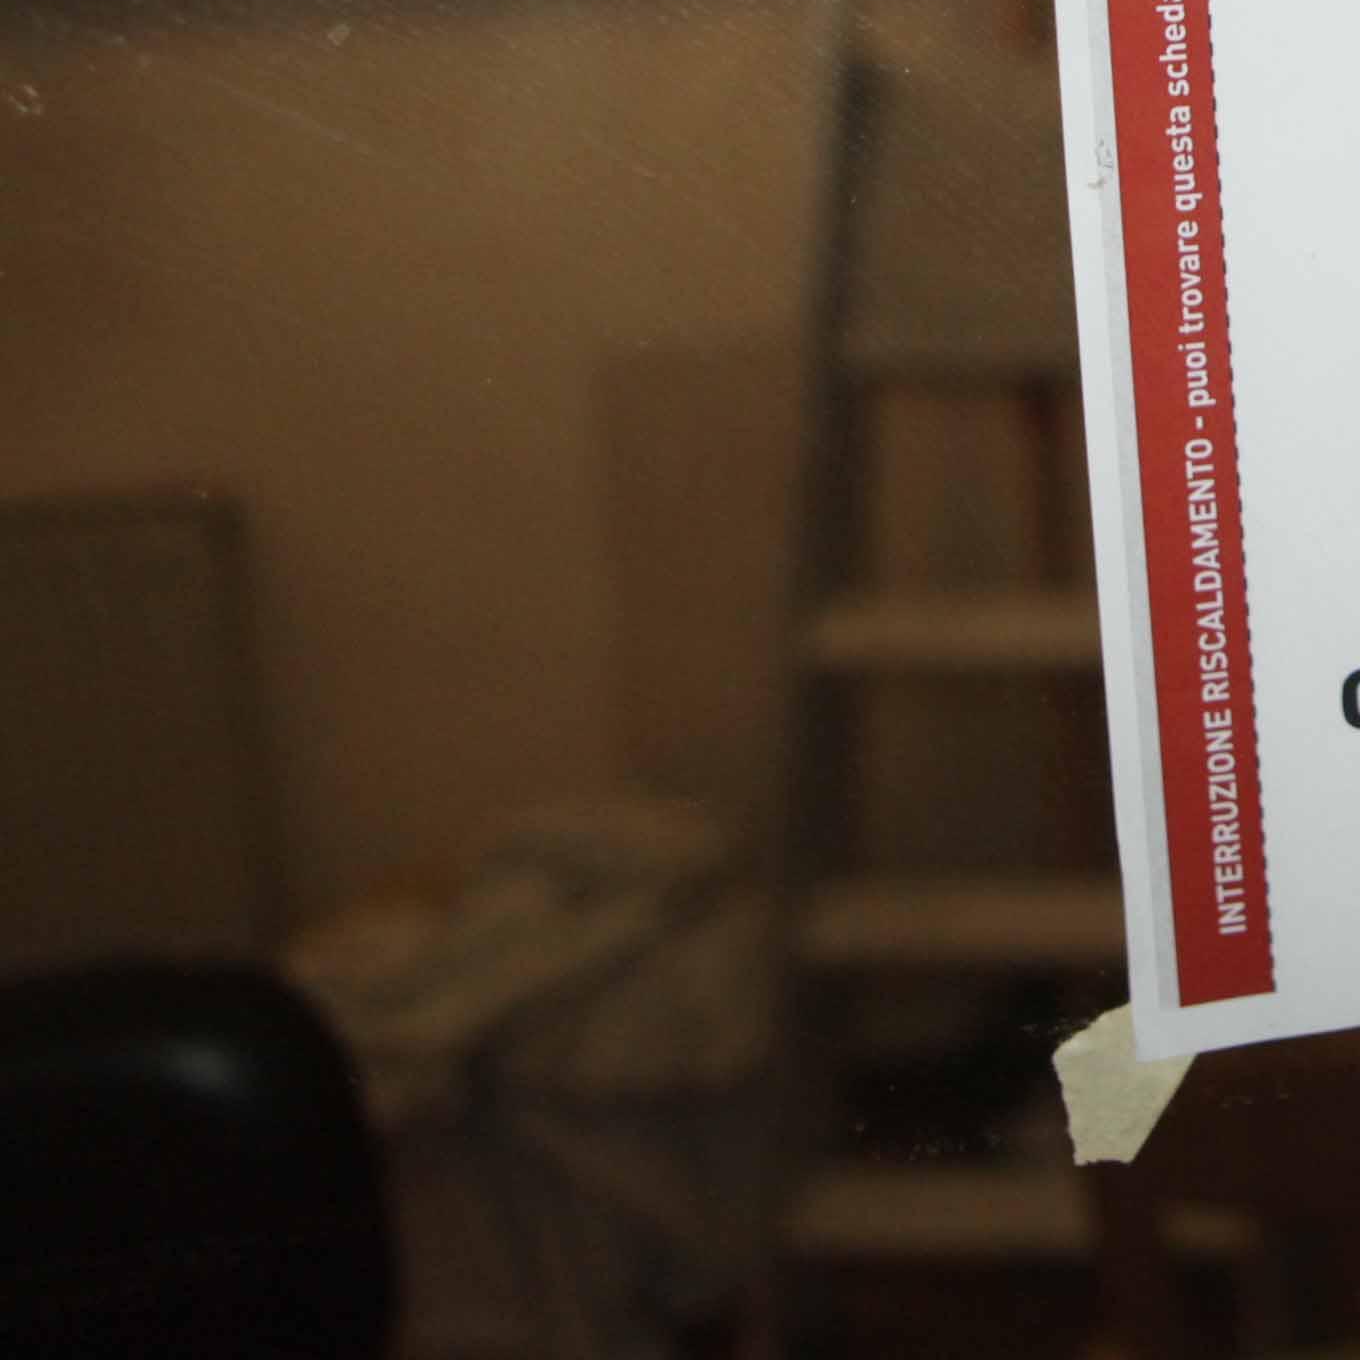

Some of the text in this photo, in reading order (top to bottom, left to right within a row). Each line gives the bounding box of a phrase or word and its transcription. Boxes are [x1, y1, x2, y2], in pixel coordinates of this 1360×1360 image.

[1166, 106, 1203, 211] questa
[1177, 220, 1205, 334] trovare
[1178, 340, 1217, 408] puoi
[1185, 440, 1229, 700] RISCALDAMENTO
[1204, 709, 1247, 936] INTERRUZIONE
